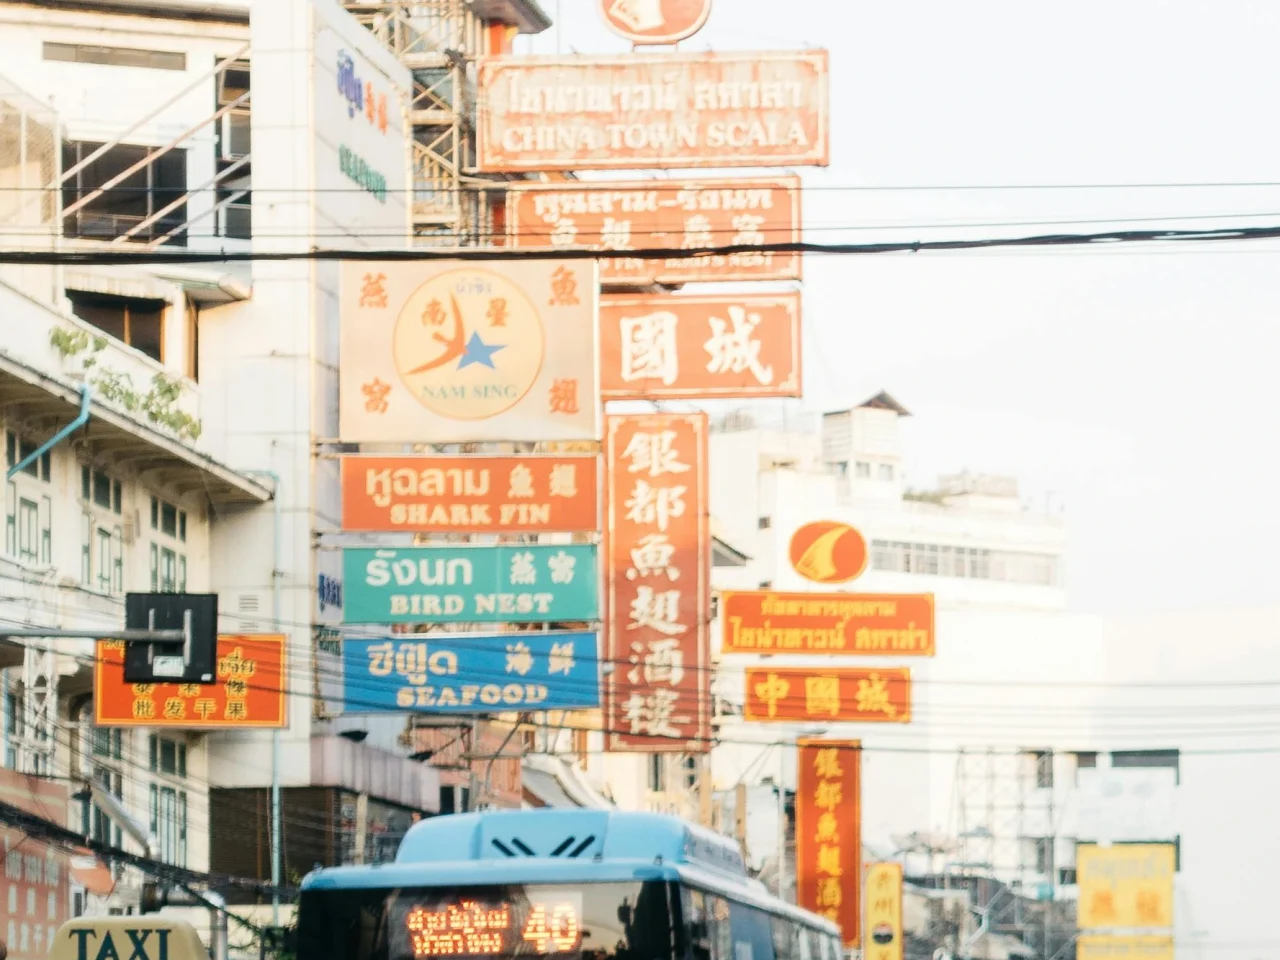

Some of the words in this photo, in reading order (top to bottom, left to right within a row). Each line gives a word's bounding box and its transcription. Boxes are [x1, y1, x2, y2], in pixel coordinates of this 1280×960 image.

[501, 125, 598, 151] CHINA
[606, 123, 698, 149] TOWN
[706, 120, 808, 146] SCALA
[422, 385, 466, 399] NAM
[473, 385, 518, 399] SING
[365, 466, 490, 508] หูฉลาม
[390, 503, 492, 526] SHARK
[499, 502, 551, 525] FIN
[365, 549, 473, 587] รังนก
[390, 594, 465, 616] BIRD
[474, 592, 554, 614] NEST
[396, 684, 548, 708] SEAFOOD
[522, 904, 579, 954] 40
